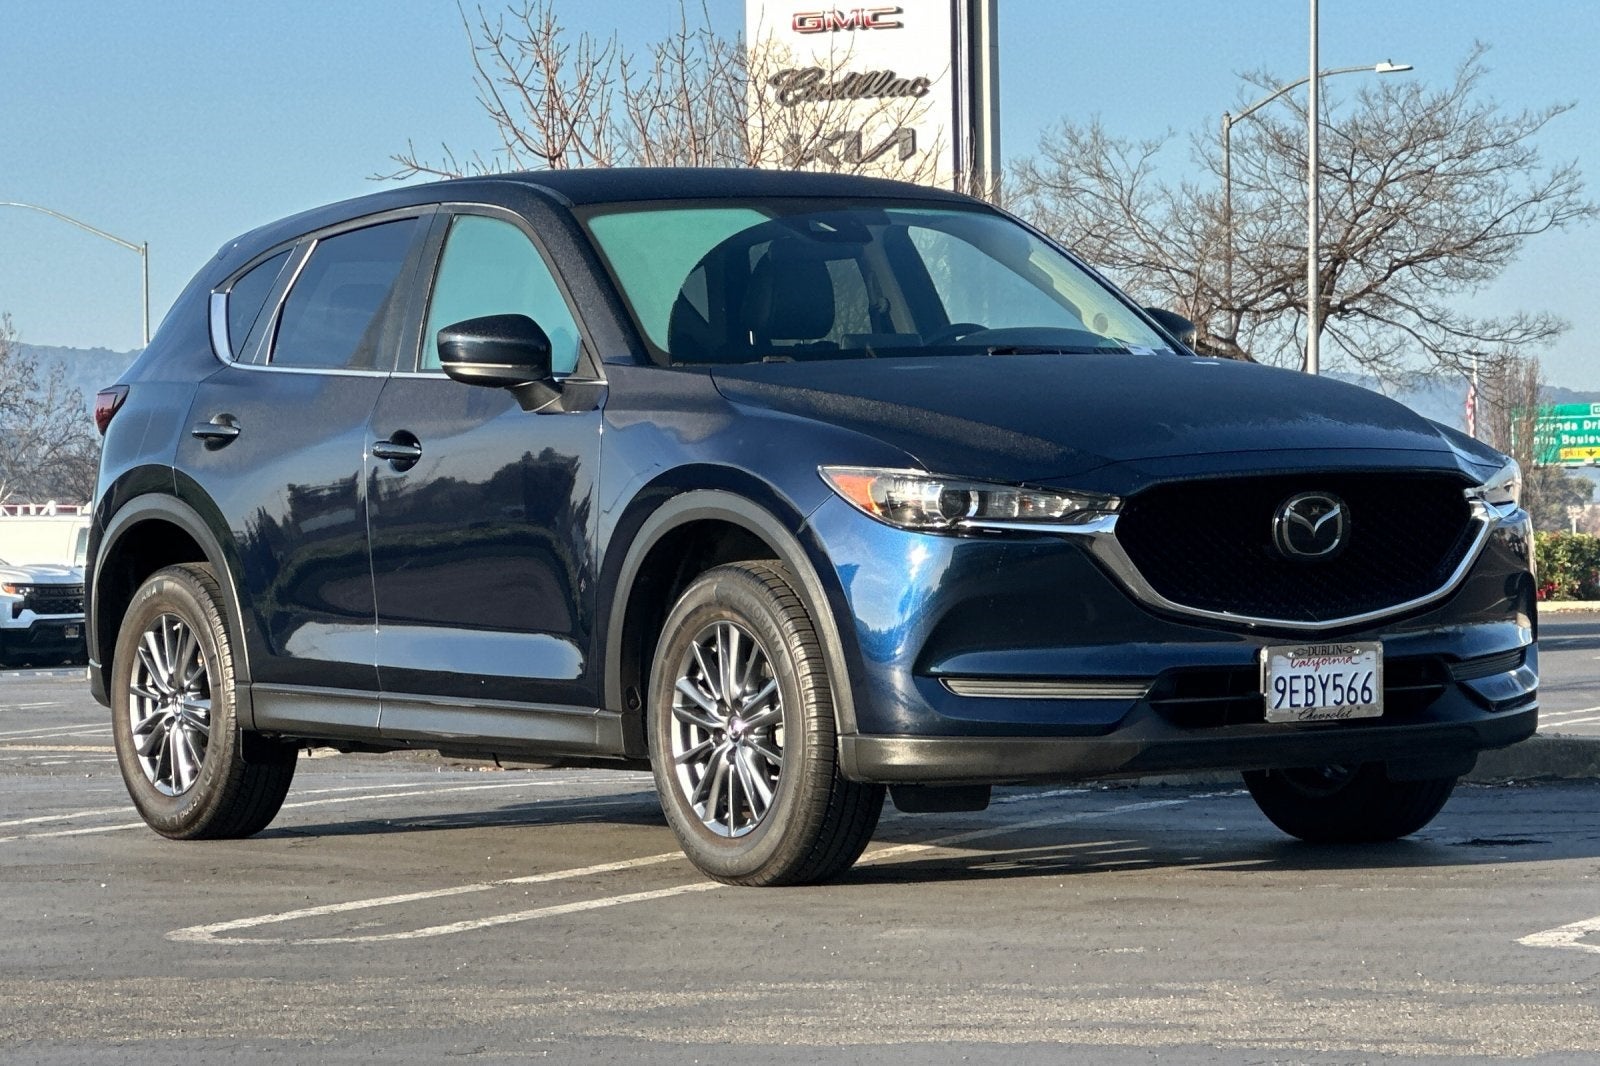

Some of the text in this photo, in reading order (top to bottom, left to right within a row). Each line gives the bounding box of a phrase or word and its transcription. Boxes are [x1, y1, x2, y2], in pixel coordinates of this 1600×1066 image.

[792, 7, 903, 33] GMC
[768, 66, 931, 107] Cadillac
[1307, 644, 1343, 657] DUBLIN
[1290, 656, 1361, 672] California
[1274, 671, 1373, 709] 9EBY566
[1298, 706, 1352, 721] Chevrolet
